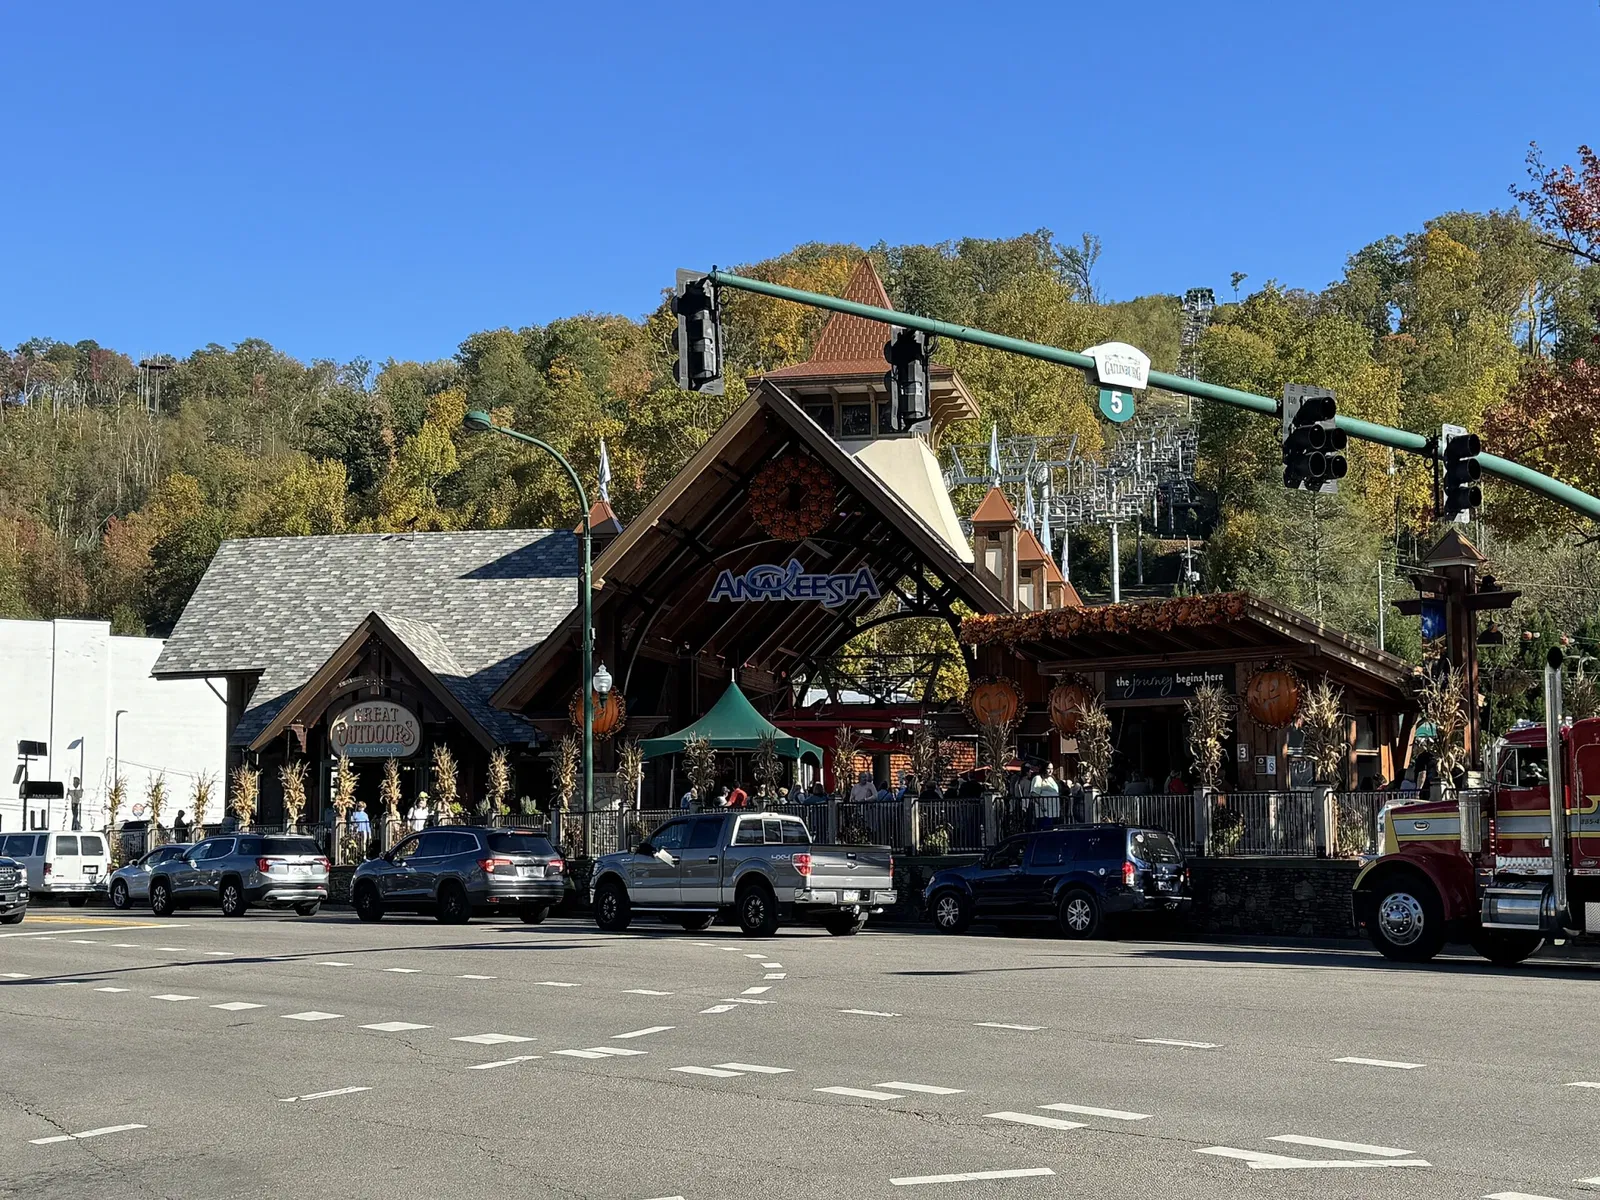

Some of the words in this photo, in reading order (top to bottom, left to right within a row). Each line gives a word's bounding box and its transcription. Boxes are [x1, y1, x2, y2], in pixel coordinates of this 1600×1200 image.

[1105, 361, 1142, 381] GATLINBURG
[1111, 391, 1123, 414] 5
[707, 562, 882, 608] ANAKEESTA
[1116, 677, 1130, 687] the
[1124, 674, 1172, 698] journey
[1176, 672, 1203, 686] begins
[1204, 671, 1224, 681] here
[354, 707, 399, 722] GREAT
[336, 720, 416, 747] OUTDOORS
[1239, 747, 1247, 758] 3
